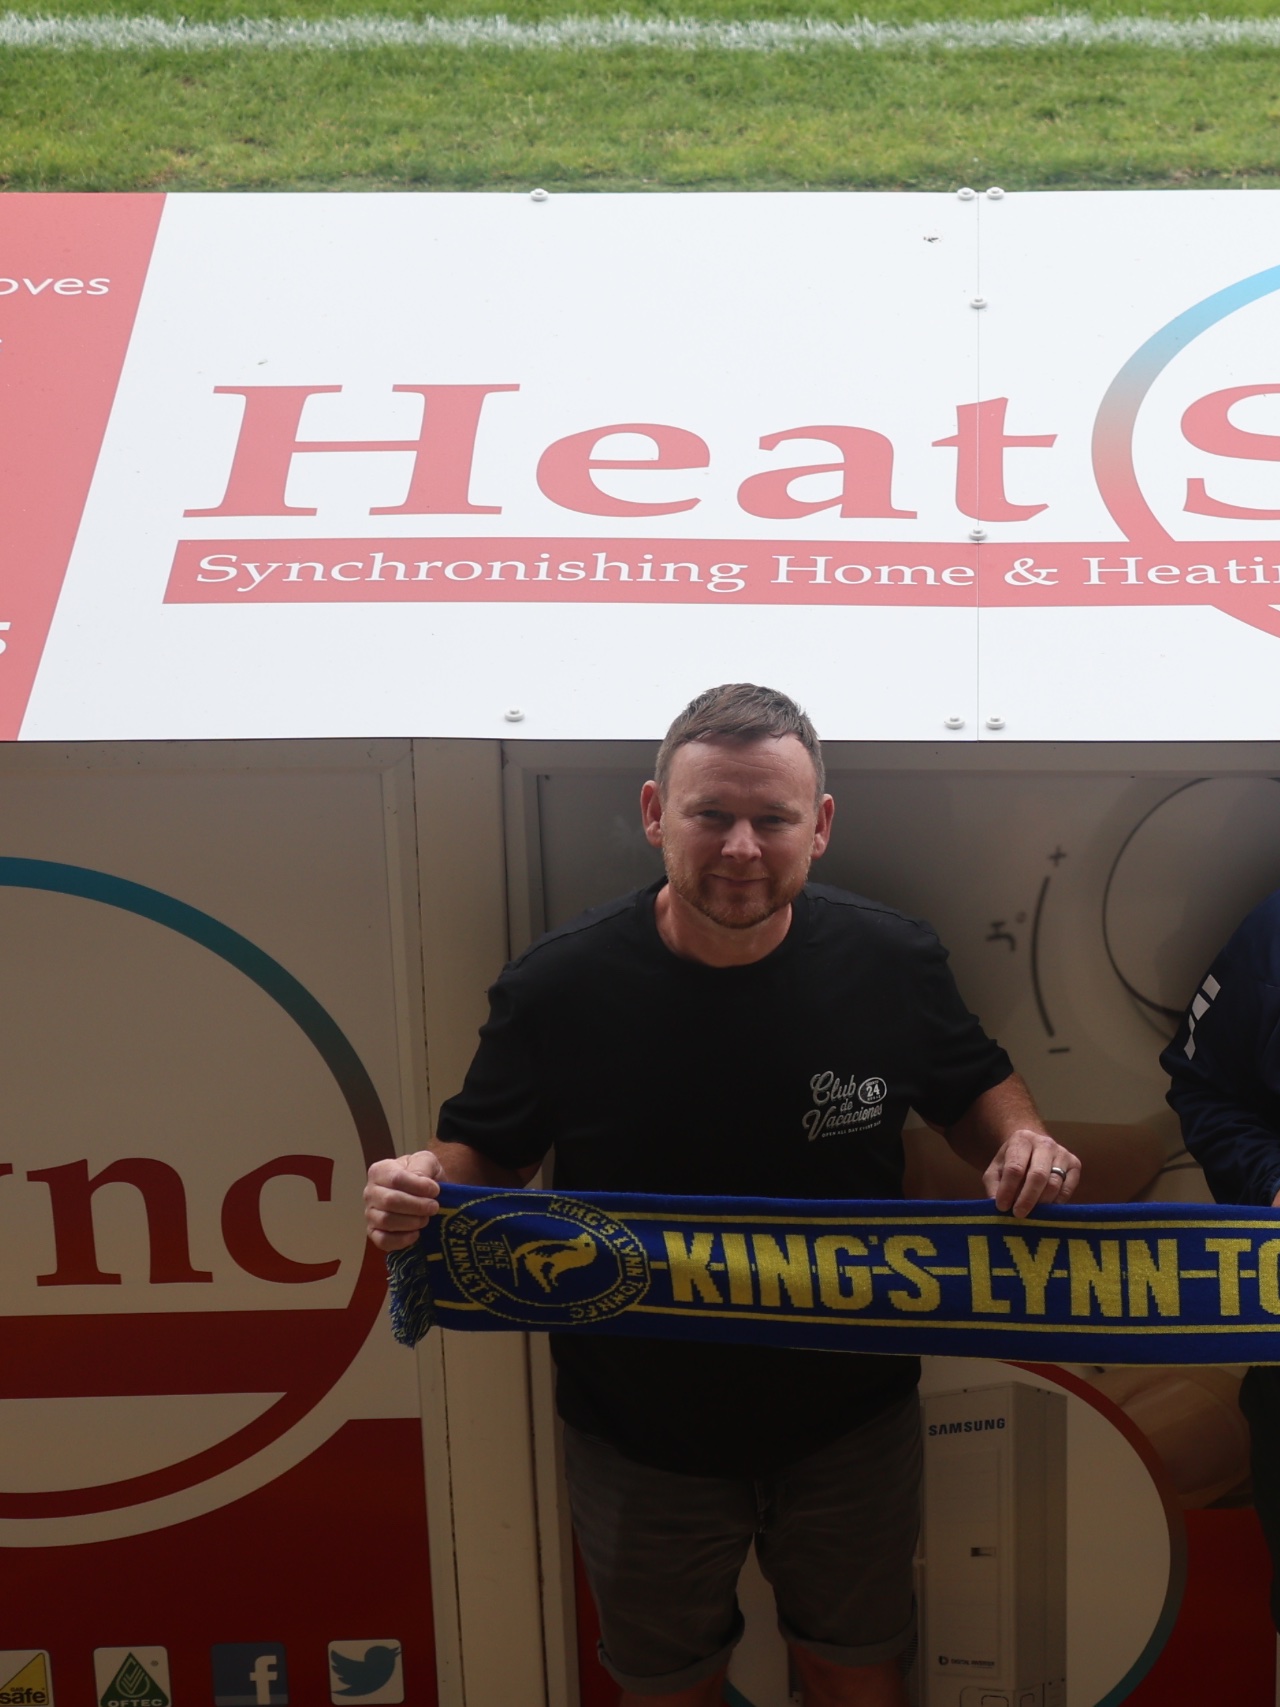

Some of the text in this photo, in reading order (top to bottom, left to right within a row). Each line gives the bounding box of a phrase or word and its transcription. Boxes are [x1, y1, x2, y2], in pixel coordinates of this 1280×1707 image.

[183, 382, 1058, 523] Heat
[196, 552, 748, 593] Synchronishing
[770, 555, 976, 586] Home
[1003, 557, 1059, 586] &
[809, 1070, 857, 1106] Club
[839, 1098, 853, 1112] de
[866, 1083, 881, 1098] 24
[0, 1153, 342, 1287] nc
[662, 1230, 942, 1313] KING'S
[966, 1234, 1181, 1318] LYNN
[928, 1417, 1006, 1436] SAMSUNG
